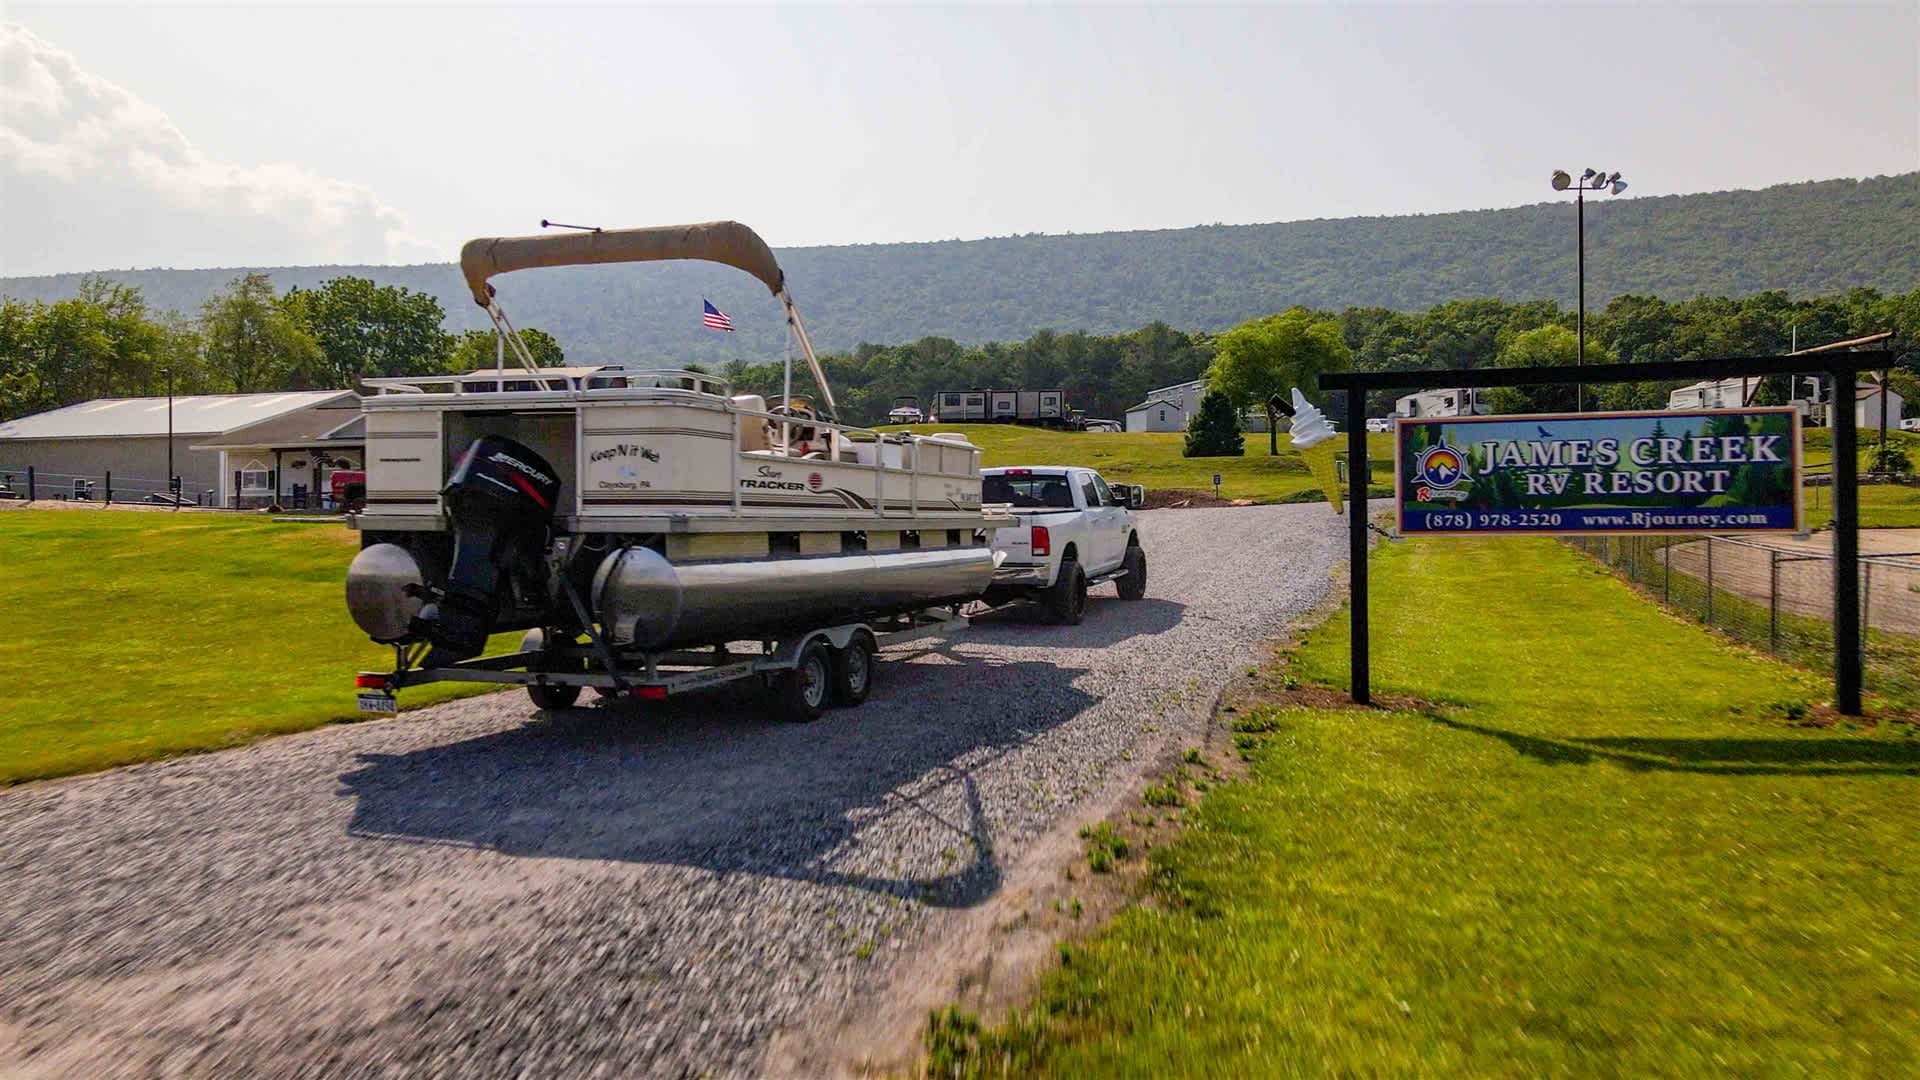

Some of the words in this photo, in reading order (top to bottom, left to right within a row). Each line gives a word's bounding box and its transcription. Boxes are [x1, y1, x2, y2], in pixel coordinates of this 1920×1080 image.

[1478, 439, 1618, 475] JAMES
[1629, 435, 1783, 466] CREEK
[487, 451, 553, 486] MERCURY
[740, 479, 805, 491] TRACKER
[1525, 473, 1571, 495] RV
[1582, 469, 1730, 494] RESORT
[1425, 512, 1472, 529] (878)
[1479, 512, 1562, 526] 978-2520
[1582, 511, 1769, 528] www.Rjourney.com
